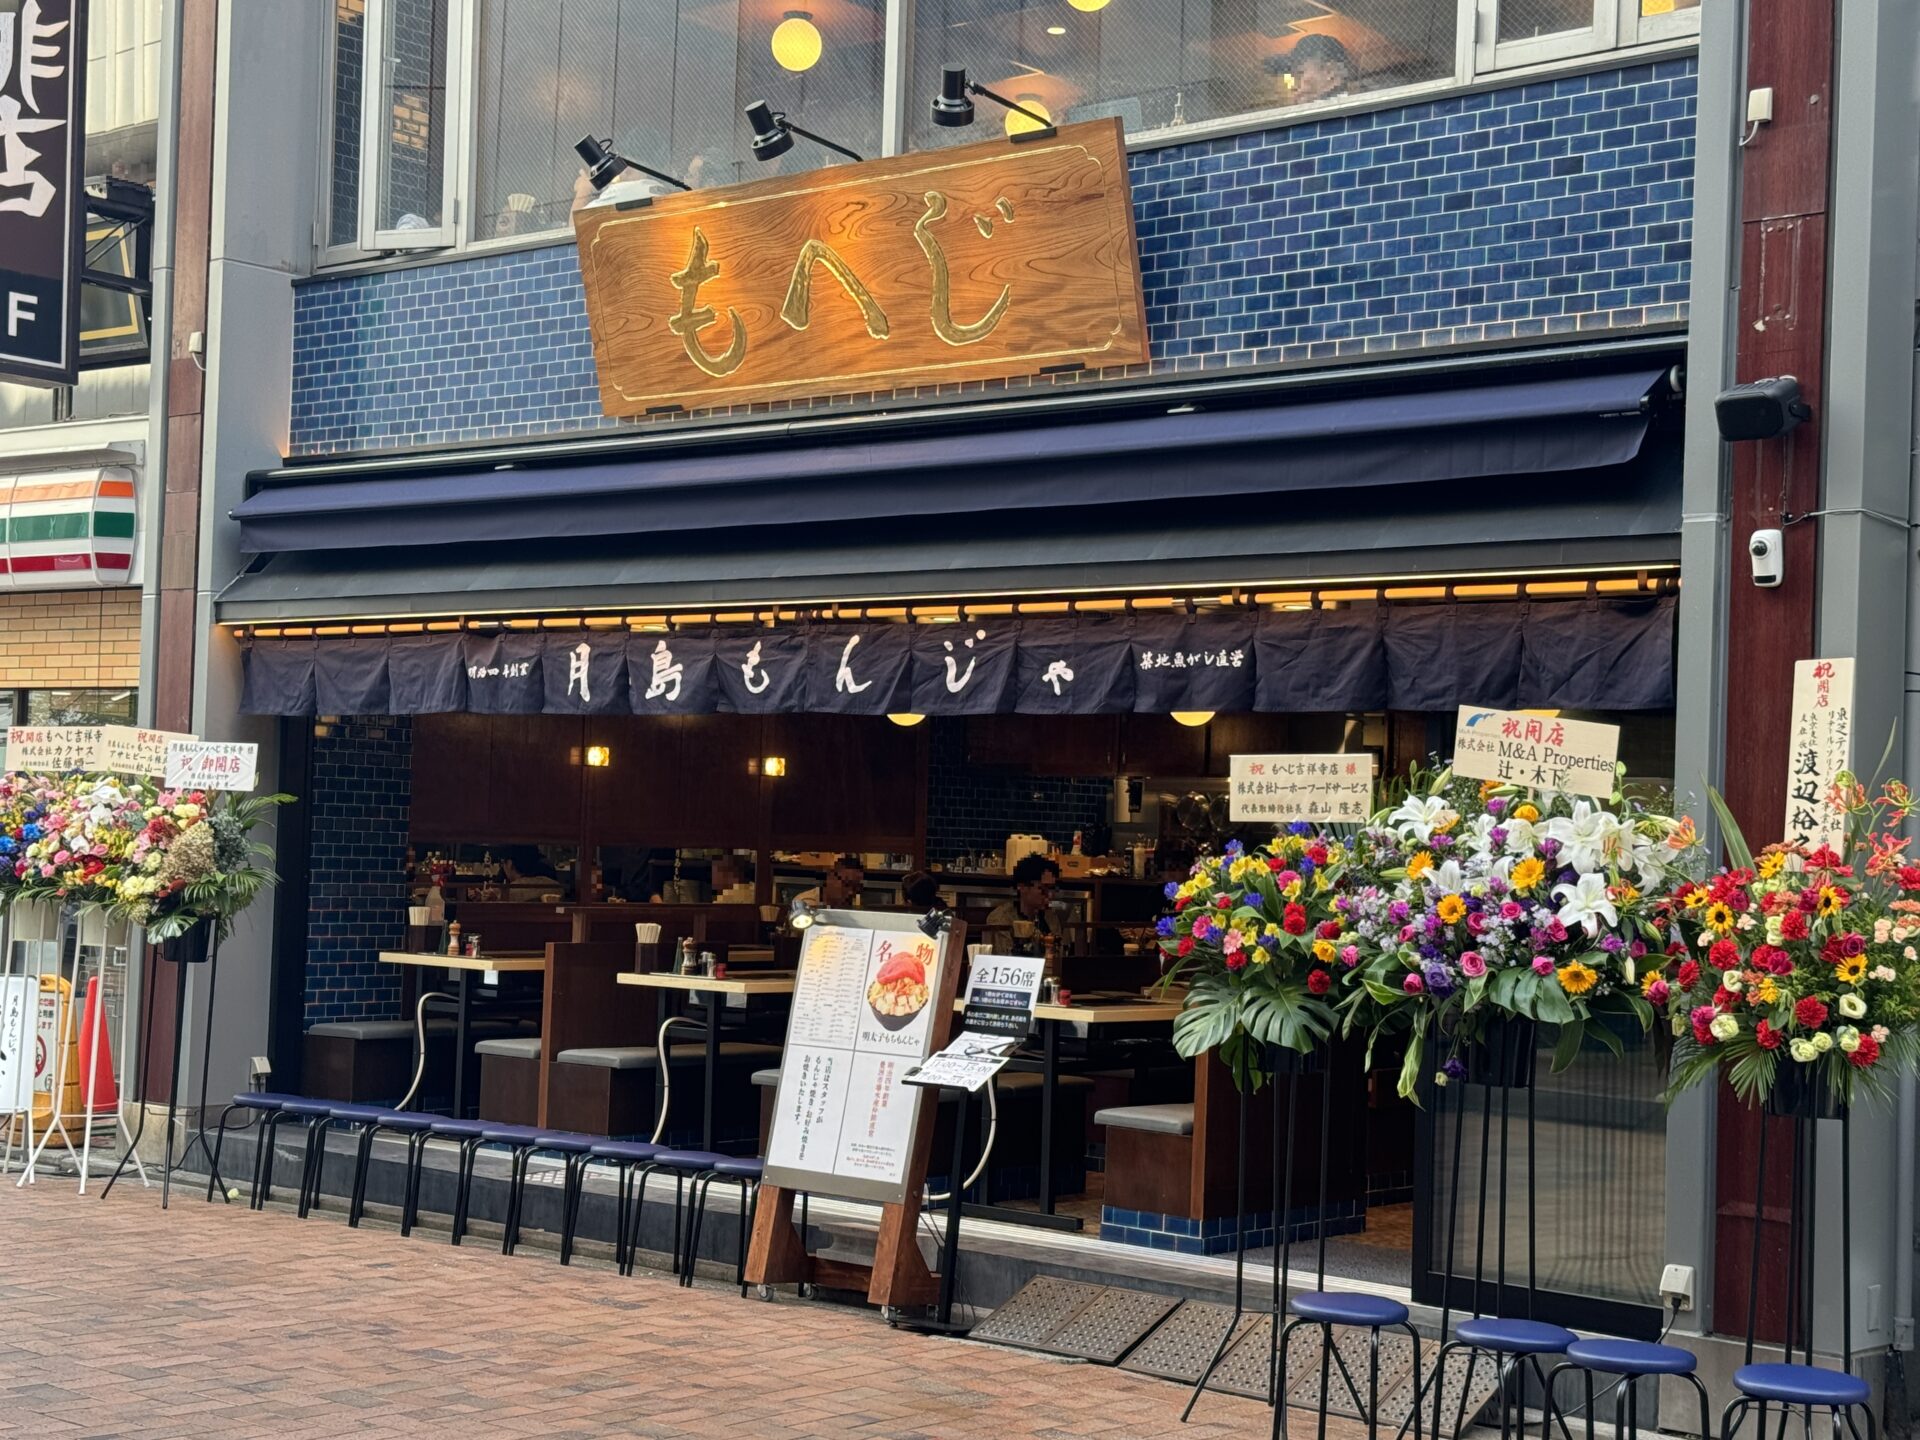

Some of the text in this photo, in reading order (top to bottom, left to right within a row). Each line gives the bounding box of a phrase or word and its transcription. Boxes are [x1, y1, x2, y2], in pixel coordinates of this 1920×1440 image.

[668, 191, 1014, 378] もへじ
[1139, 649, 1244, 671] 築地魚がし直営
[10, 728, 103, 744] 祝開店 もへじ吉祥寺
[1501, 717, 1566, 747] 祝開店
[1457, 737, 1615, 773] 株式会社 M&A Properties
[1249, 762, 1357, 776] 祝 もへじ吉祥寺店 様
[1237, 781, 1369, 795] 株式会社トーホーフードサービス
